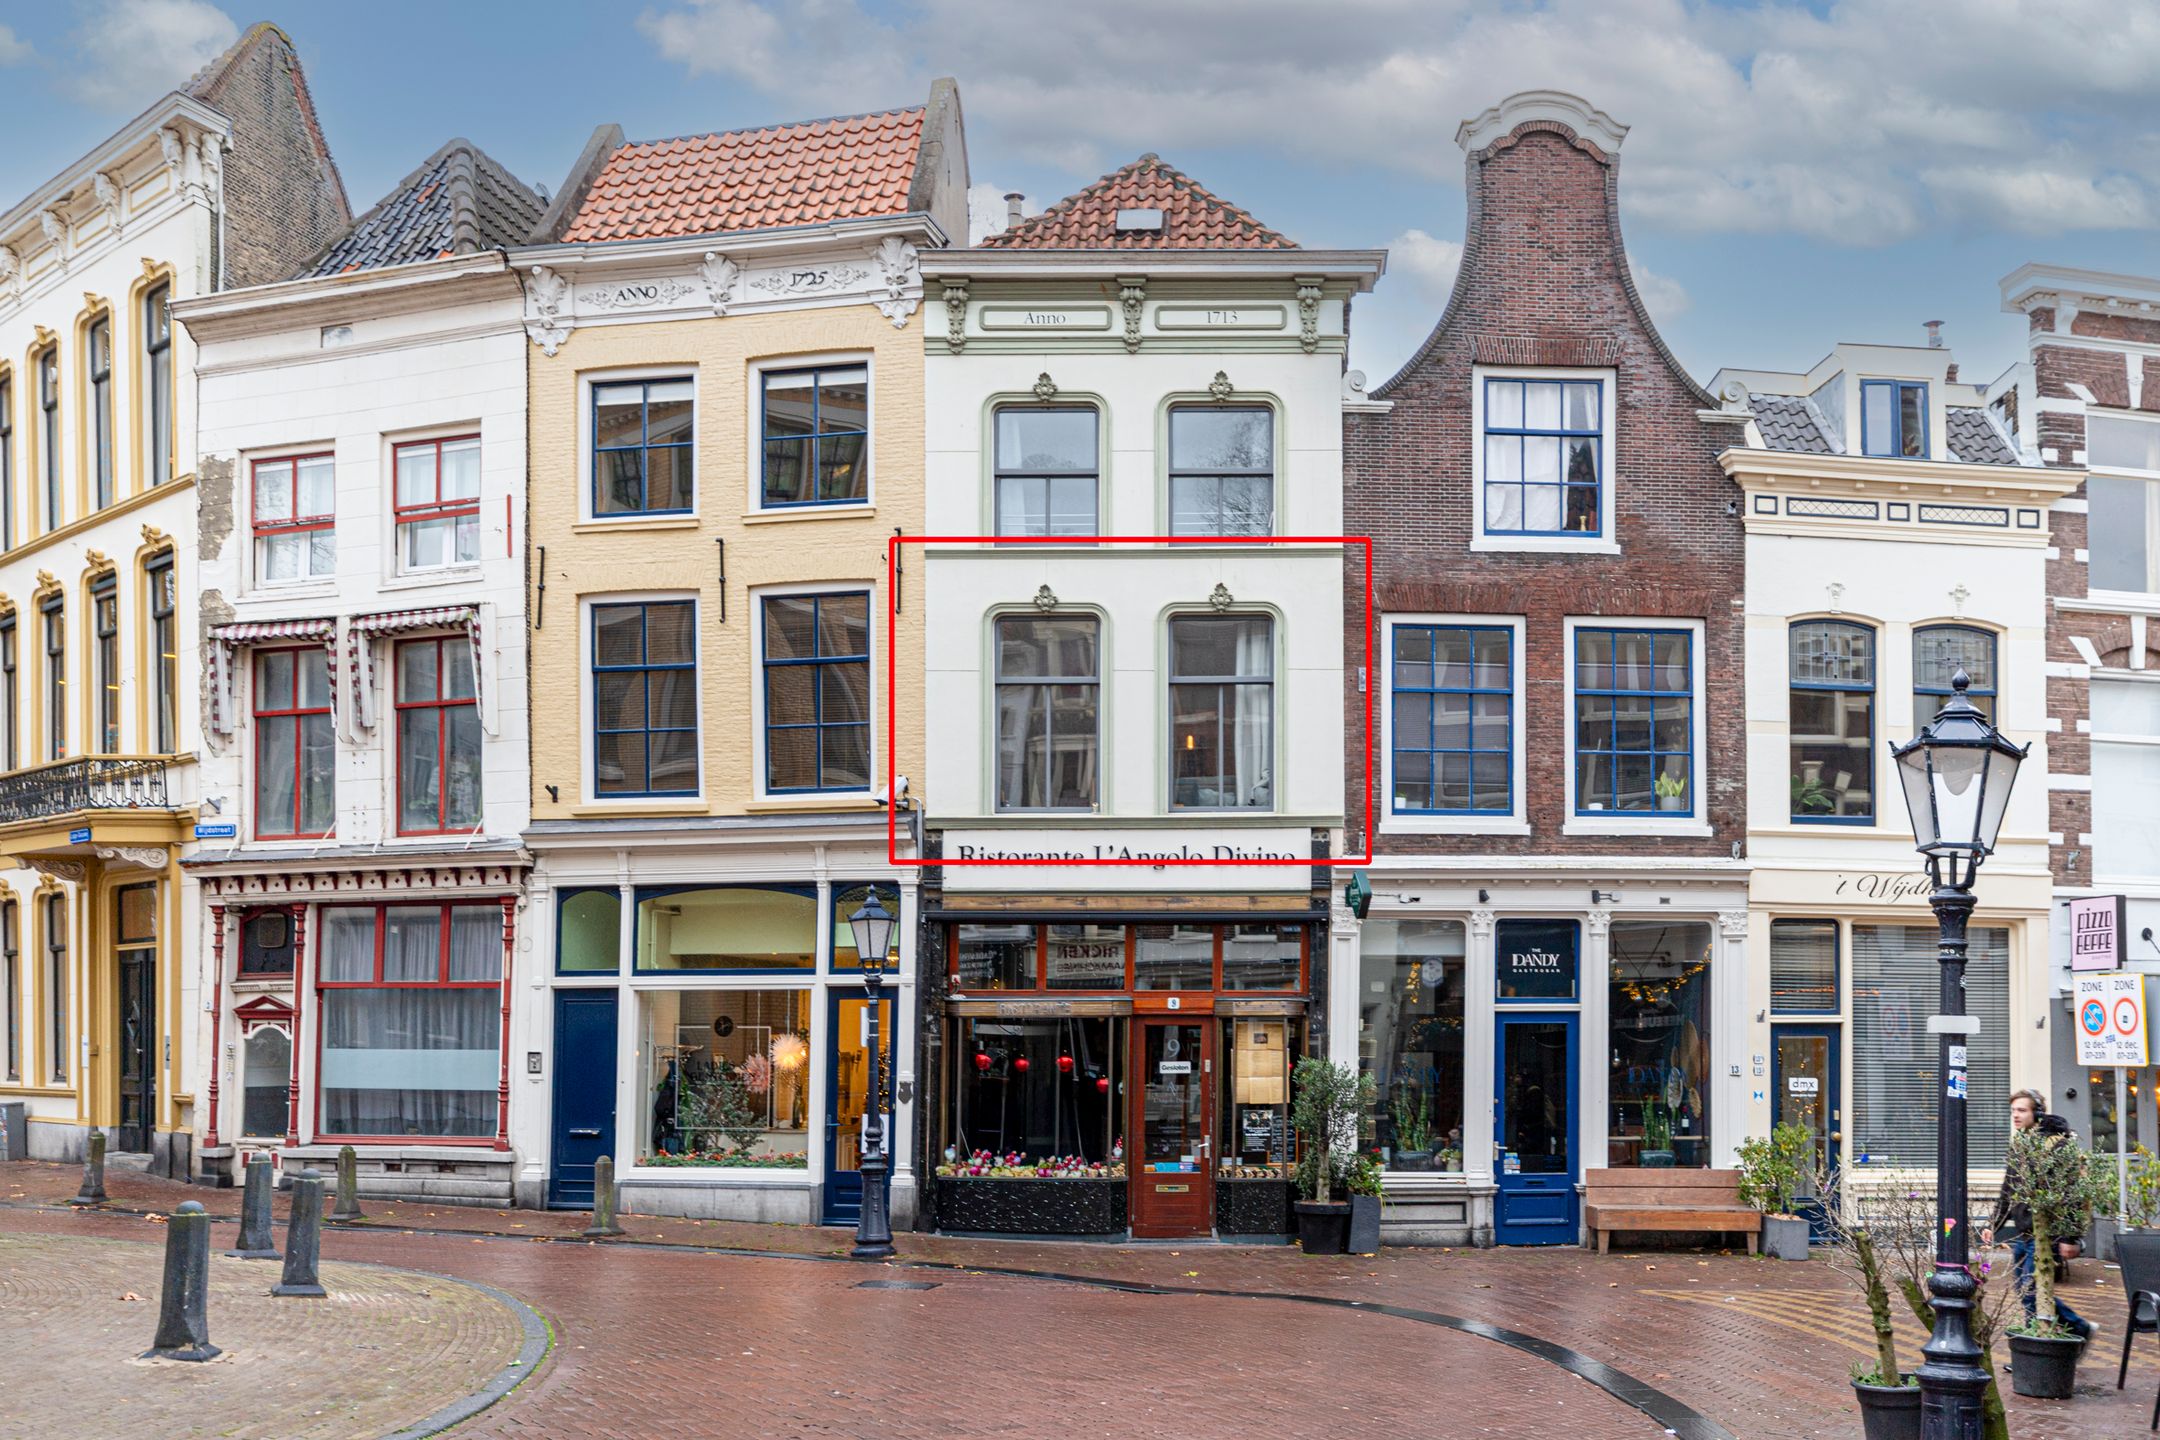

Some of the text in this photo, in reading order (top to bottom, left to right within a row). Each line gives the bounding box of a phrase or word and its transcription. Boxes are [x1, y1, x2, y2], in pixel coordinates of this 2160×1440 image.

[615, 271, 828, 301] ANNO 1725
[1023, 311, 1238, 325] Anno 1713
[958, 844, 1085, 867] Ristorante
[1211, 844, 1296, 867] Divino
[1856, 873, 1937, 904] Wijdh
[1512, 953, 1560, 967] DANDY
[2081, 979, 2135, 992] ZONE ZONE
[1167, 1038, 1181, 1058] 9
[1731, 1065, 1740, 1074] 13
[1792, 1078, 1815, 1089] dmx
